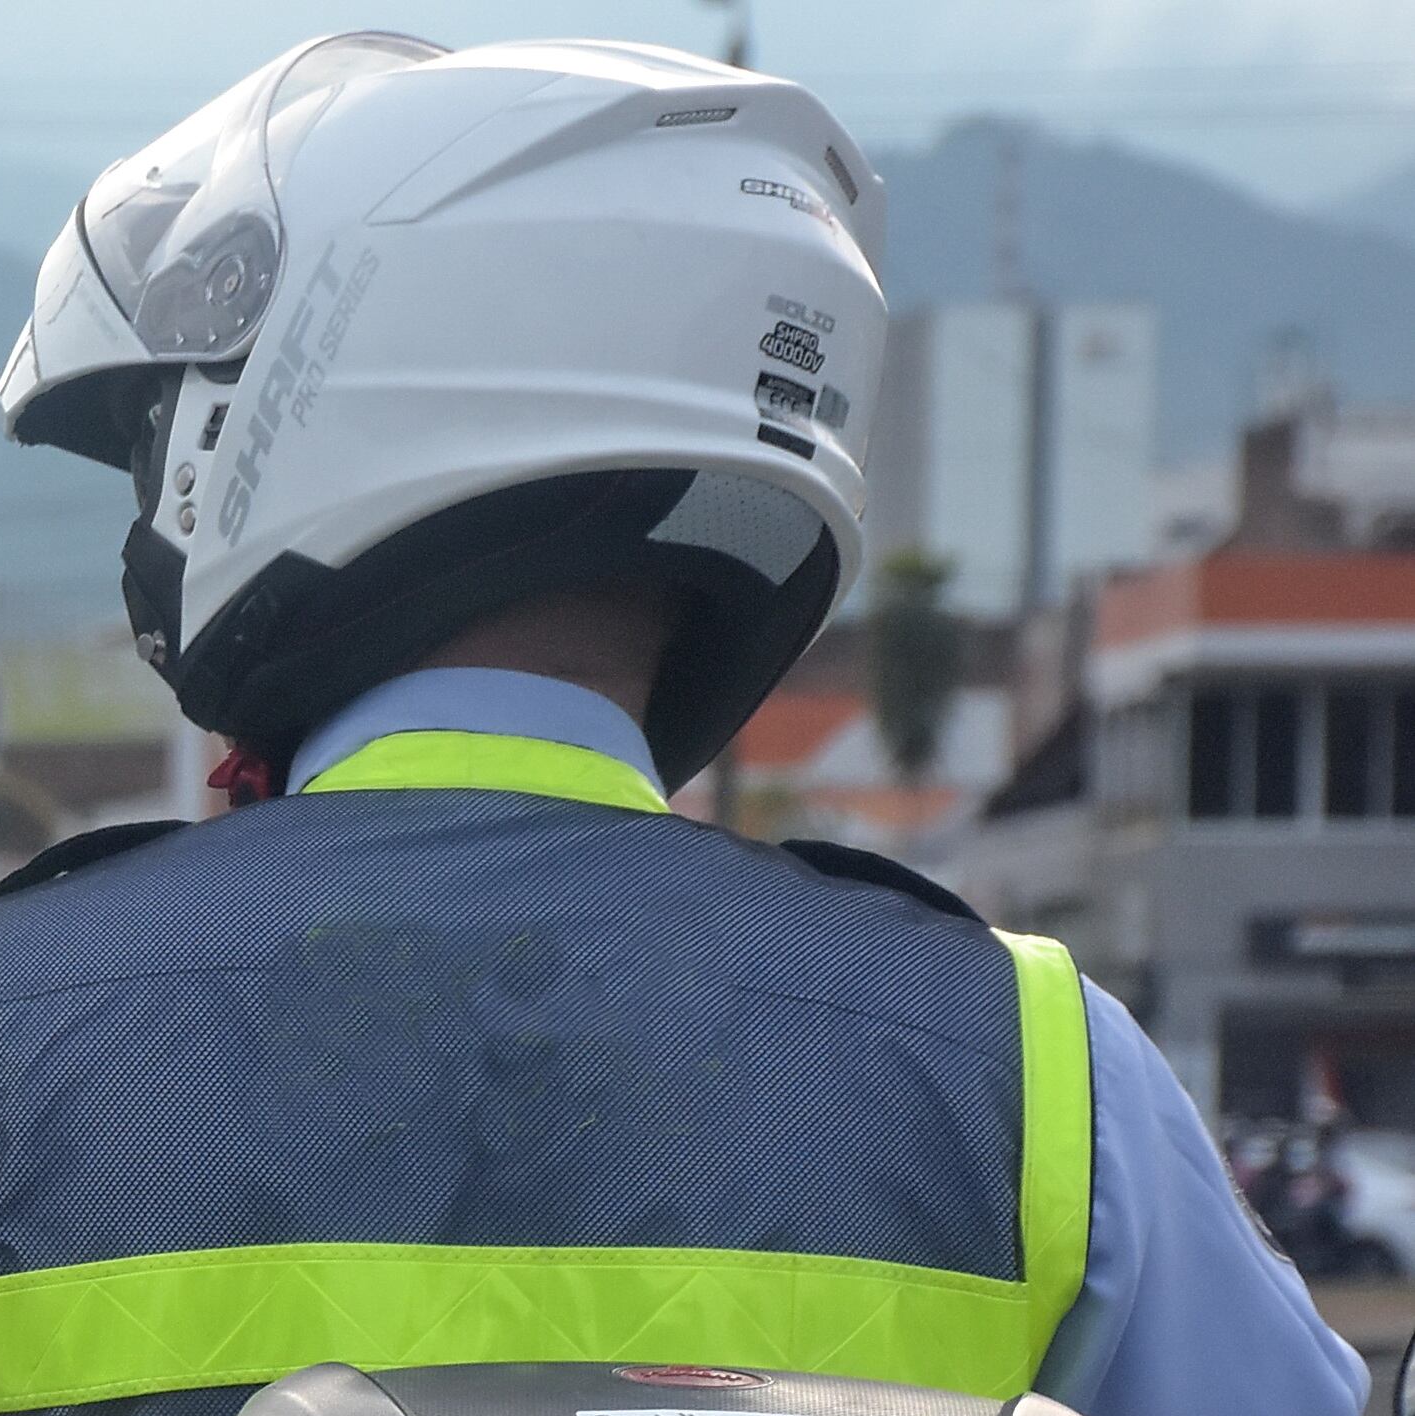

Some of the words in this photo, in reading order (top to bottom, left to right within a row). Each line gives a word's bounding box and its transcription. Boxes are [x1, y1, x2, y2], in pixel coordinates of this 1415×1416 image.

[218, 240, 342, 548] SHAFT
[290, 360, 325, 428] PRO
[318, 247, 380, 361] SERIES
[775, 321, 820, 351] SHPRO
